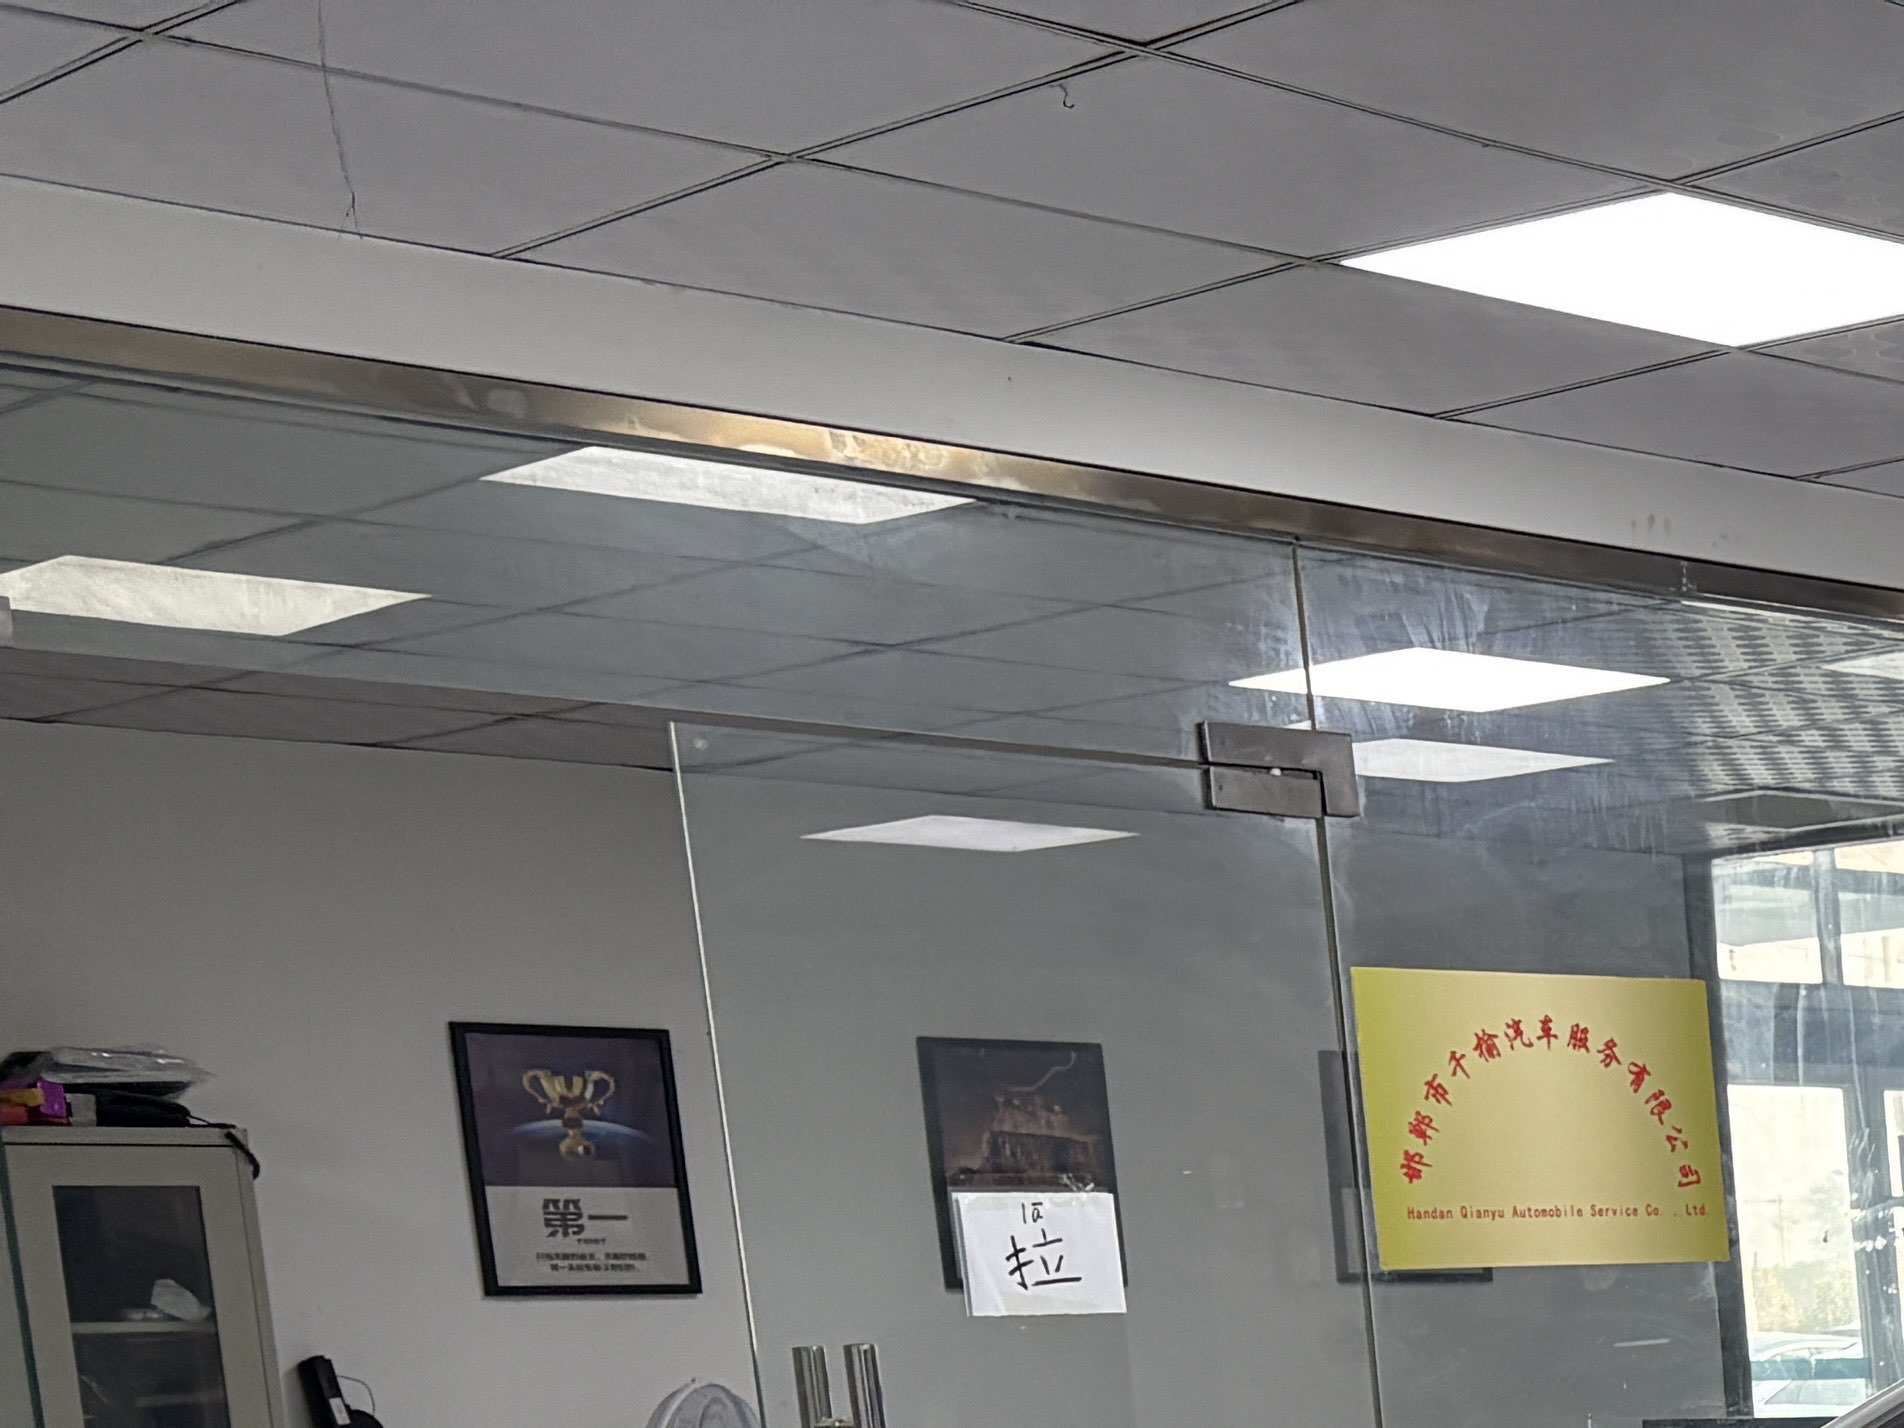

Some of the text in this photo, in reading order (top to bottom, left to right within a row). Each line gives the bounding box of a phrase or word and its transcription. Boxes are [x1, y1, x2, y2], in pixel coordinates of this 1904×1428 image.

[542, 1198, 628, 1238] 第一
[1407, 1205, 1454, 1221] Handan
[1460, 1204, 1505, 1221] Qianyu
[1512, 1204, 1584, 1219] Automobile
[1590, 1203, 1639, 1218] Service
[1005, 1227, 1083, 1291] 拉
